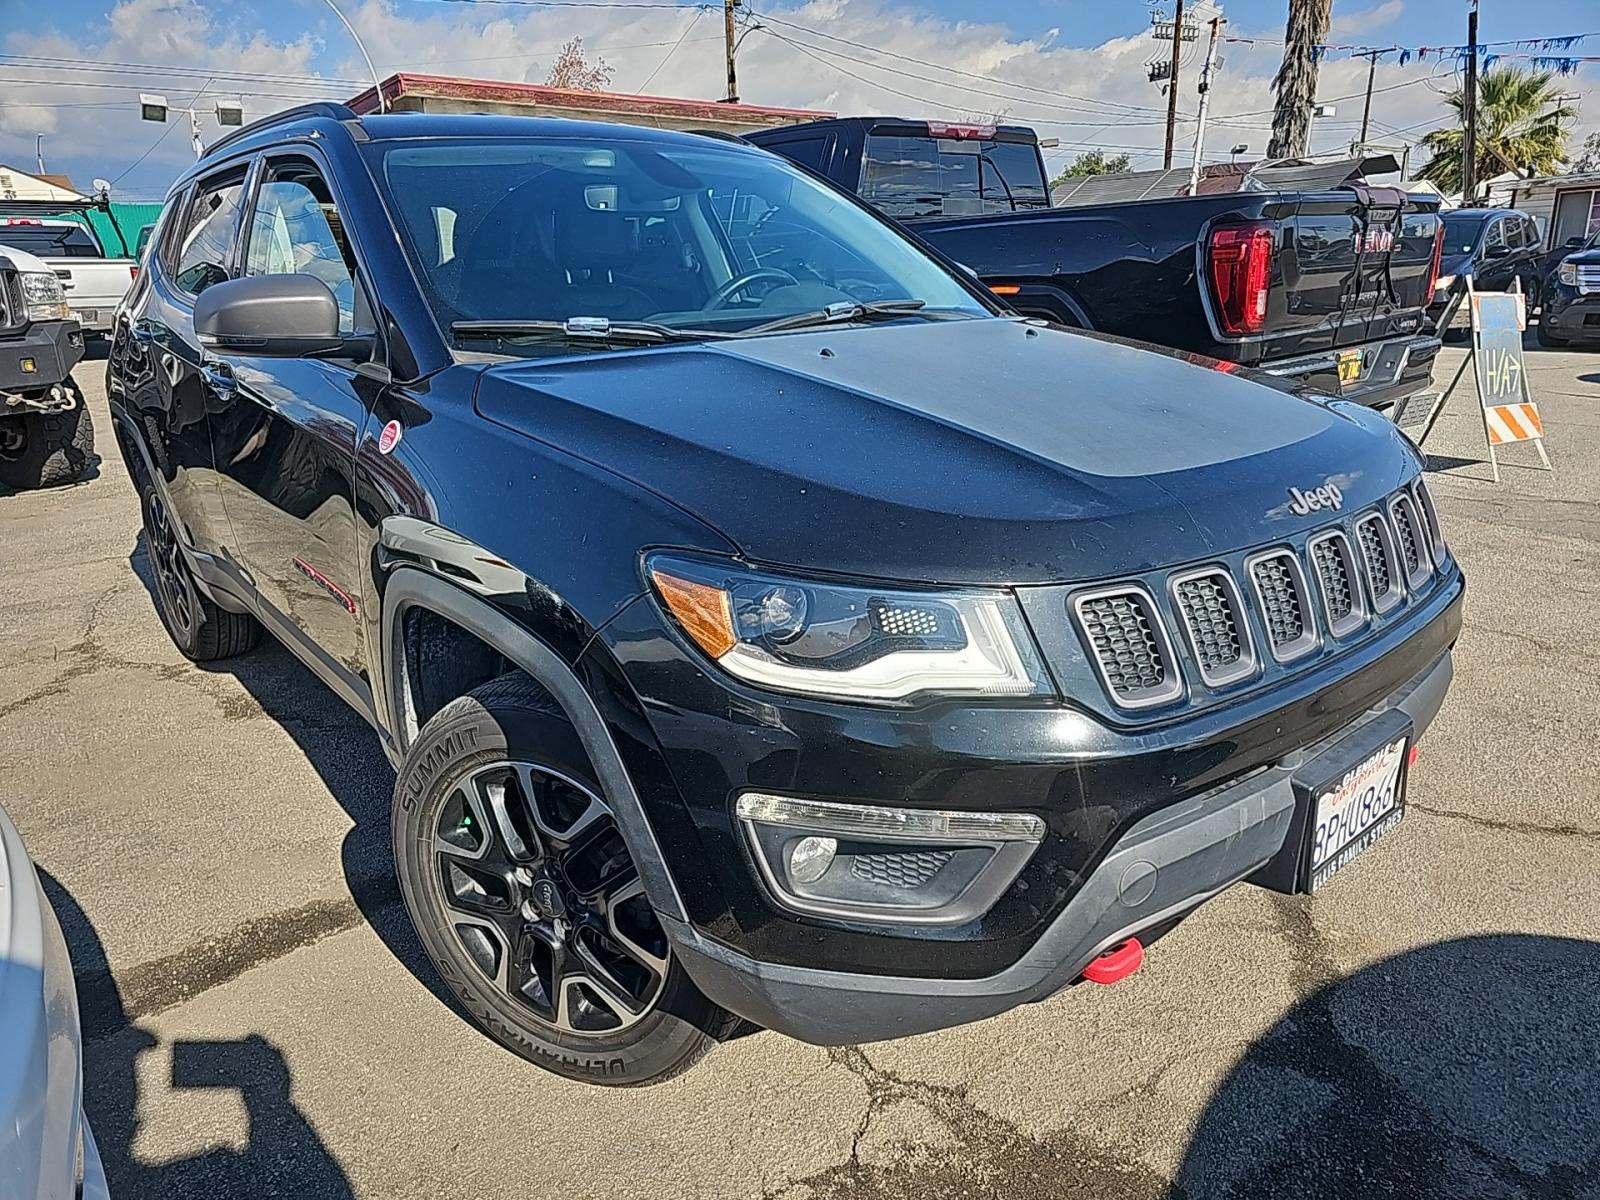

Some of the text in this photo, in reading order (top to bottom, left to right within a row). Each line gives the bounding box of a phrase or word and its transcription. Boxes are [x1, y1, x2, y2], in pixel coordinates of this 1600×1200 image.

[1288, 483, 1344, 516] Jeep
[401, 725, 481, 817] SUMMIT
[1313, 766, 1397, 867] 8PHU866
[1313, 809, 1404, 891] ELLIS FAMILY STORES
[478, 1009, 626, 1078] ULTRAMAX
